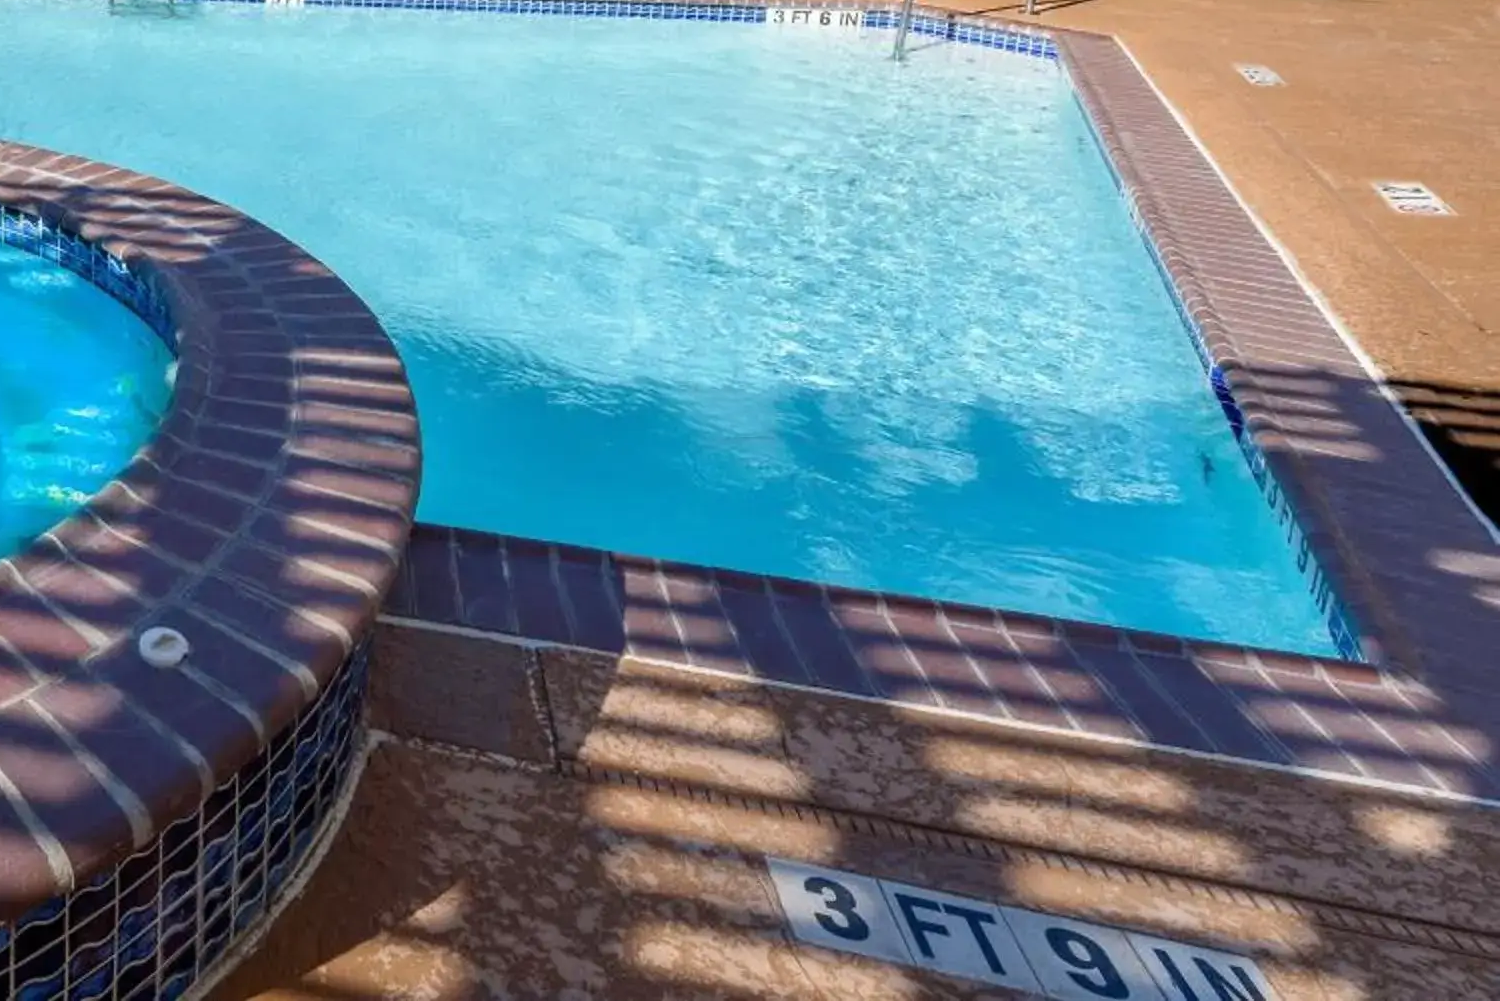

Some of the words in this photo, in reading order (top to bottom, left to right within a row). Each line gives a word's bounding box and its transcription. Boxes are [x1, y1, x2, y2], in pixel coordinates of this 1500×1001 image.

[773, 10, 784, 24] 3
[792, 10, 812, 24] FT
[820, 10, 831, 26] 6
[840, 12, 858, 26] IN
[1310, 565, 1329, 616] IN
[803, 876, 869, 941] 3
[894, 892, 1006, 975] FT
[1045, 927, 1130, 1000] 9
[1152, 946, 1268, 1001] IN
